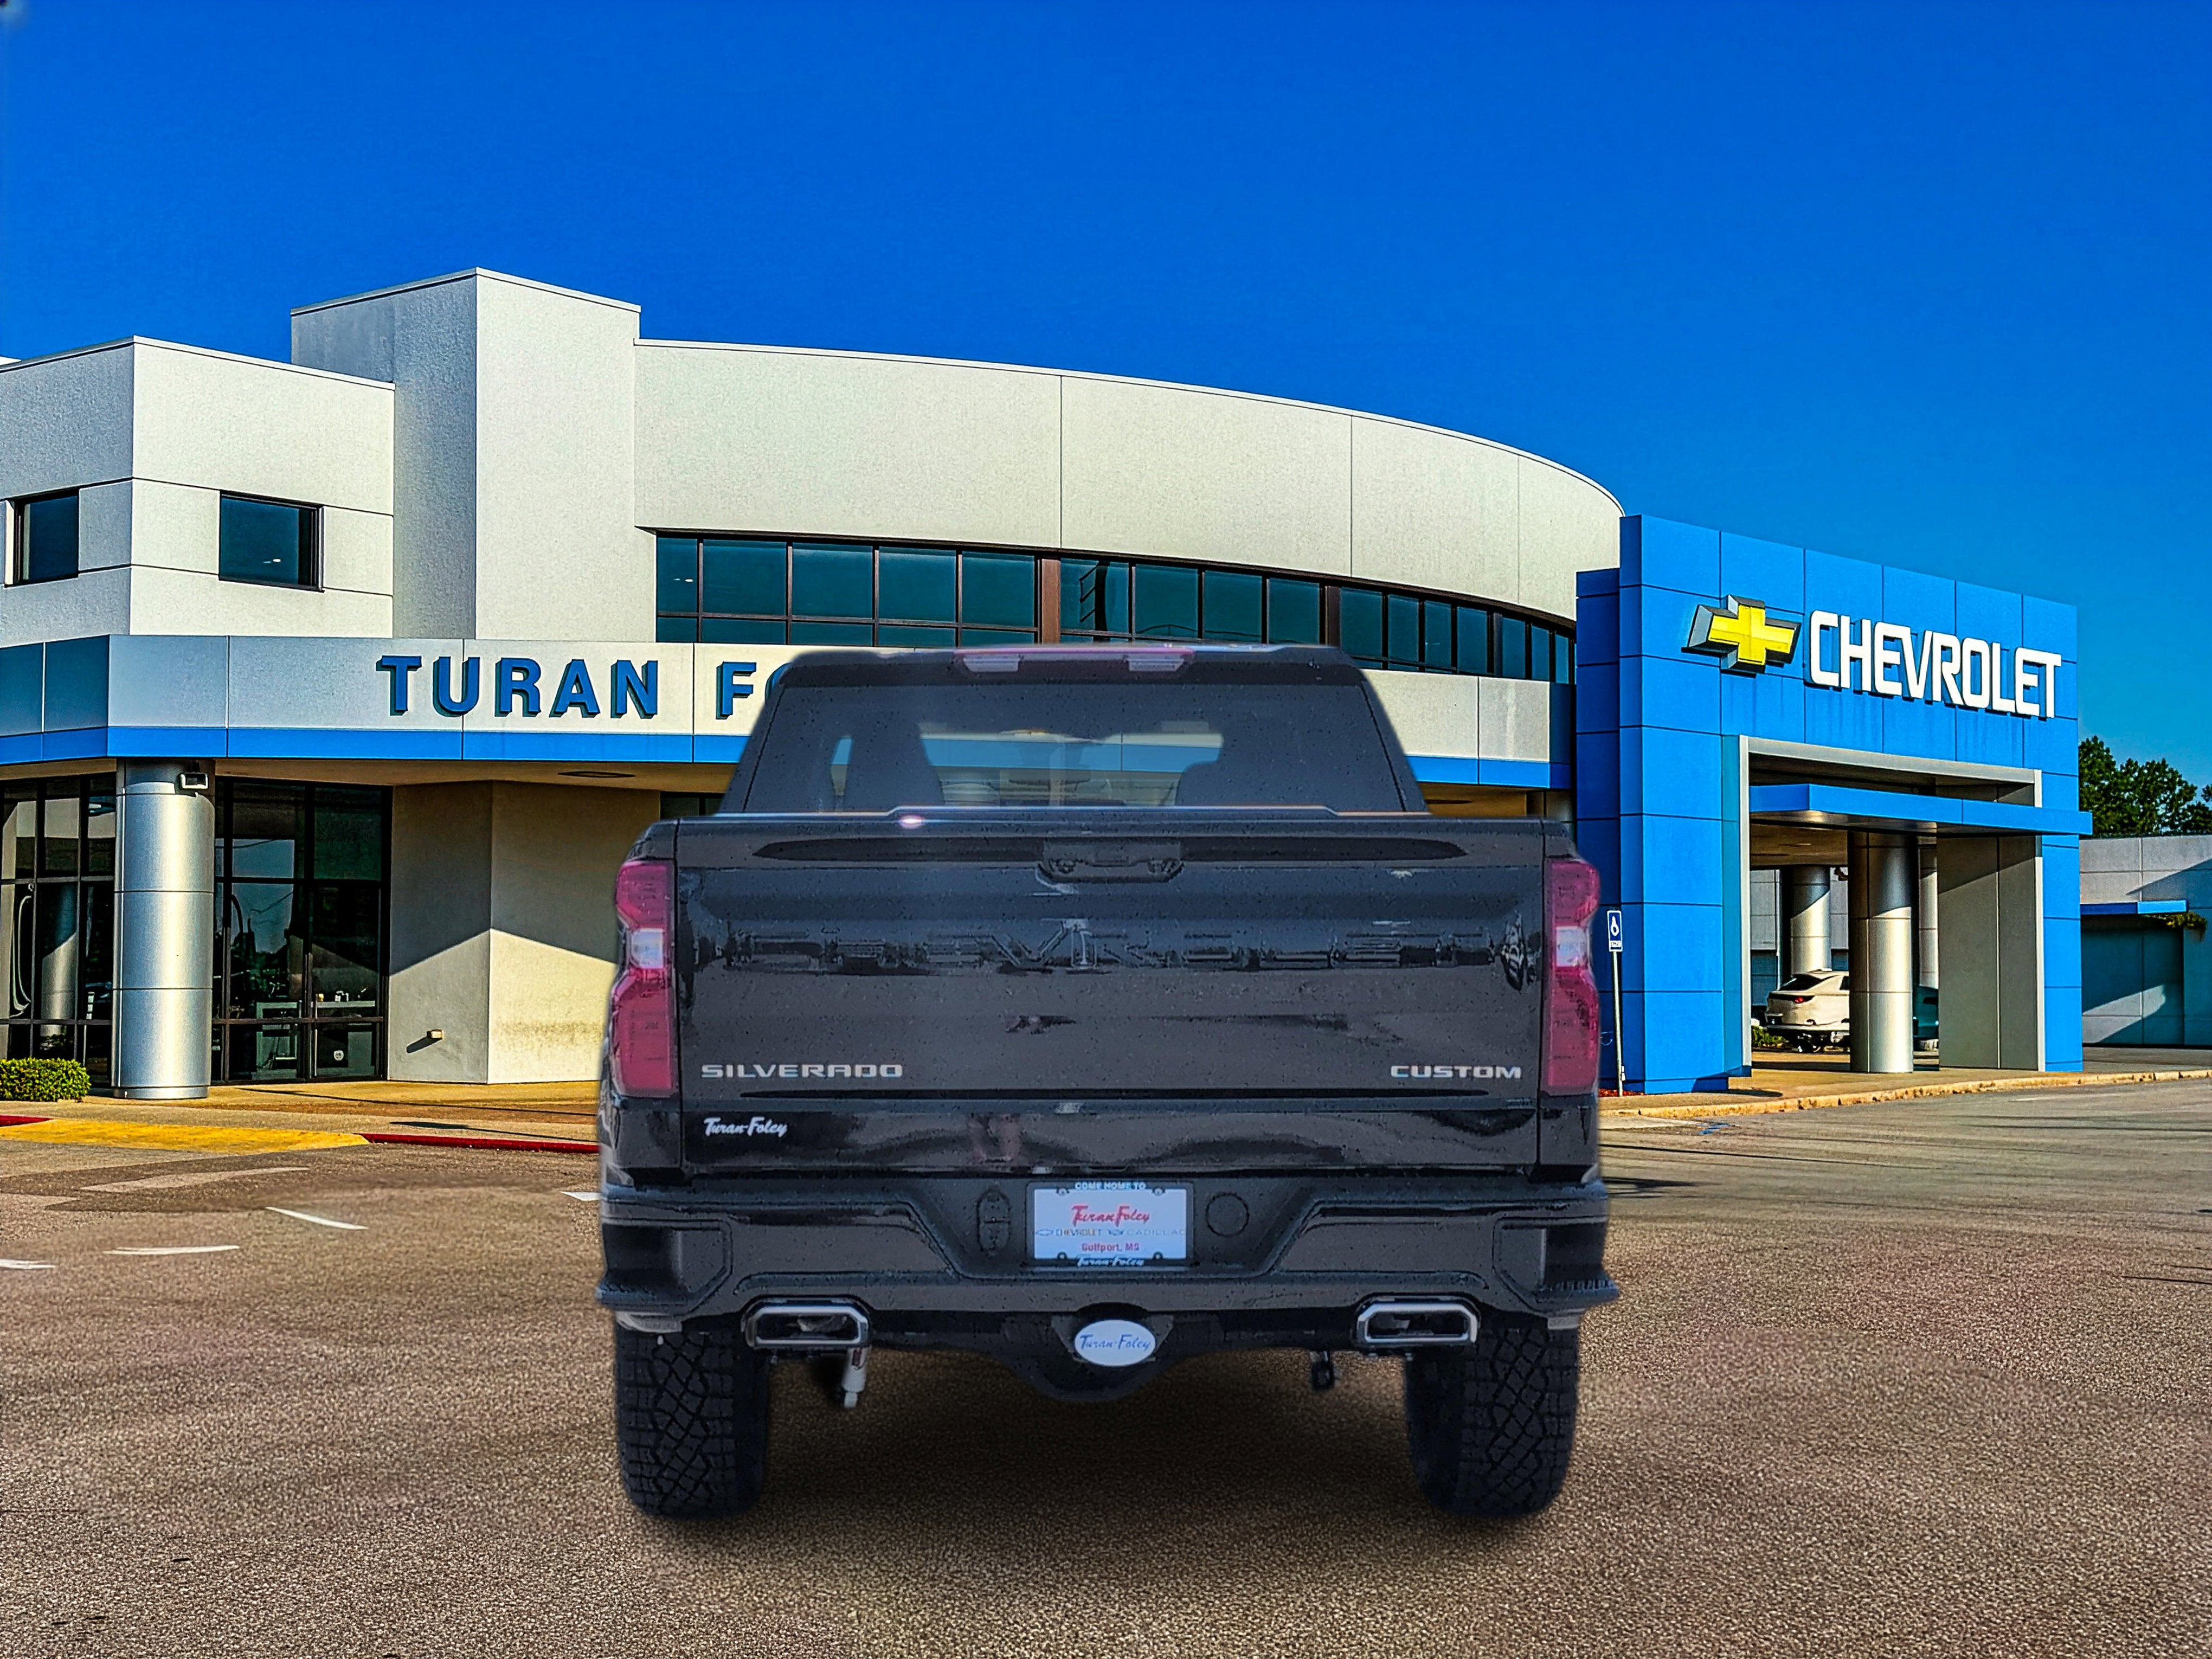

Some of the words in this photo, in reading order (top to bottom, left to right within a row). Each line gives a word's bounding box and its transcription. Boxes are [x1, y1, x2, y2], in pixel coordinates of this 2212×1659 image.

[1810, 609, 2062, 720] CHEVROLET
[375, 655, 659, 719] TURAN
[702, 1064, 903, 1078] SILVERADO
[1390, 1065, 1521, 1079] CUSTOM
[1133, 1181, 1147, 1190] TO
[1124, 1243, 1140, 1251] MS
